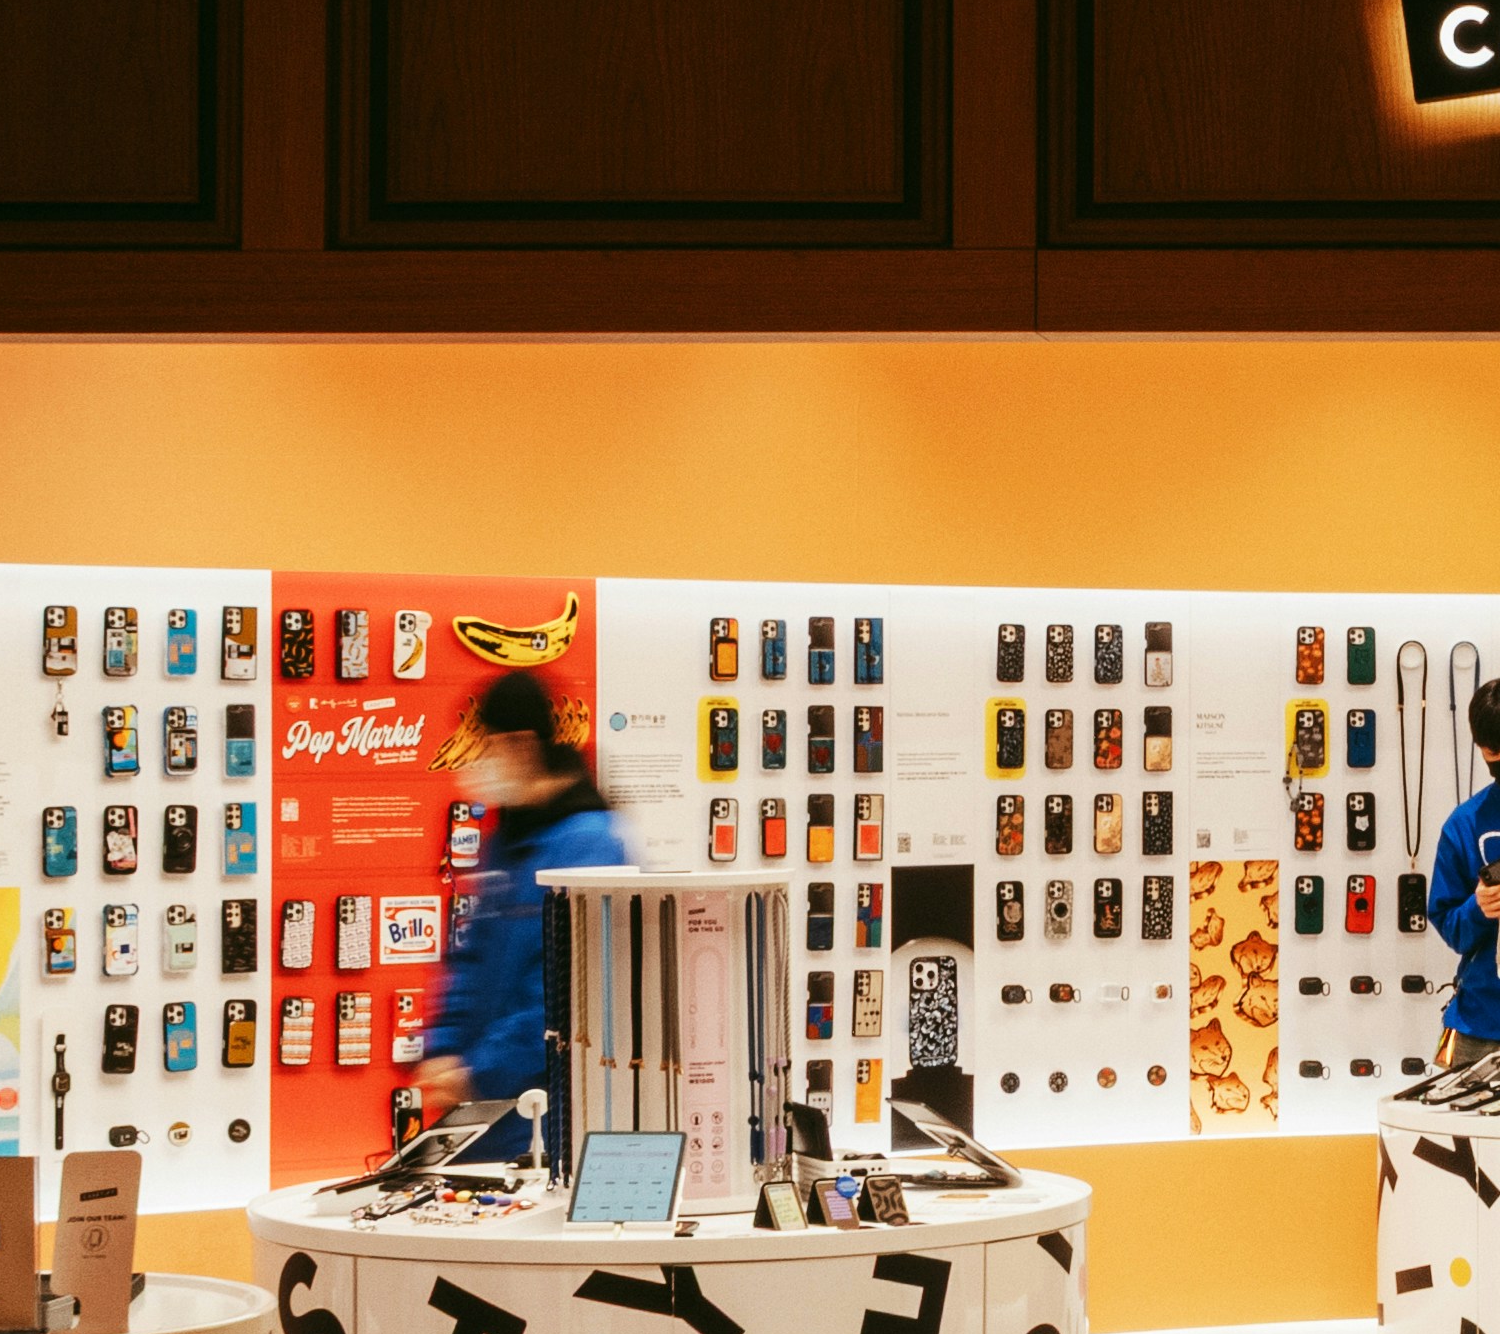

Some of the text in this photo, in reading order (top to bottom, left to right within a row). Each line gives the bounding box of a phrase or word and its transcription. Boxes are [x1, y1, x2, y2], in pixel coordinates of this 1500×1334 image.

[282, 714, 426, 763] Pop Market
[388, 918, 434, 943] Brillo
